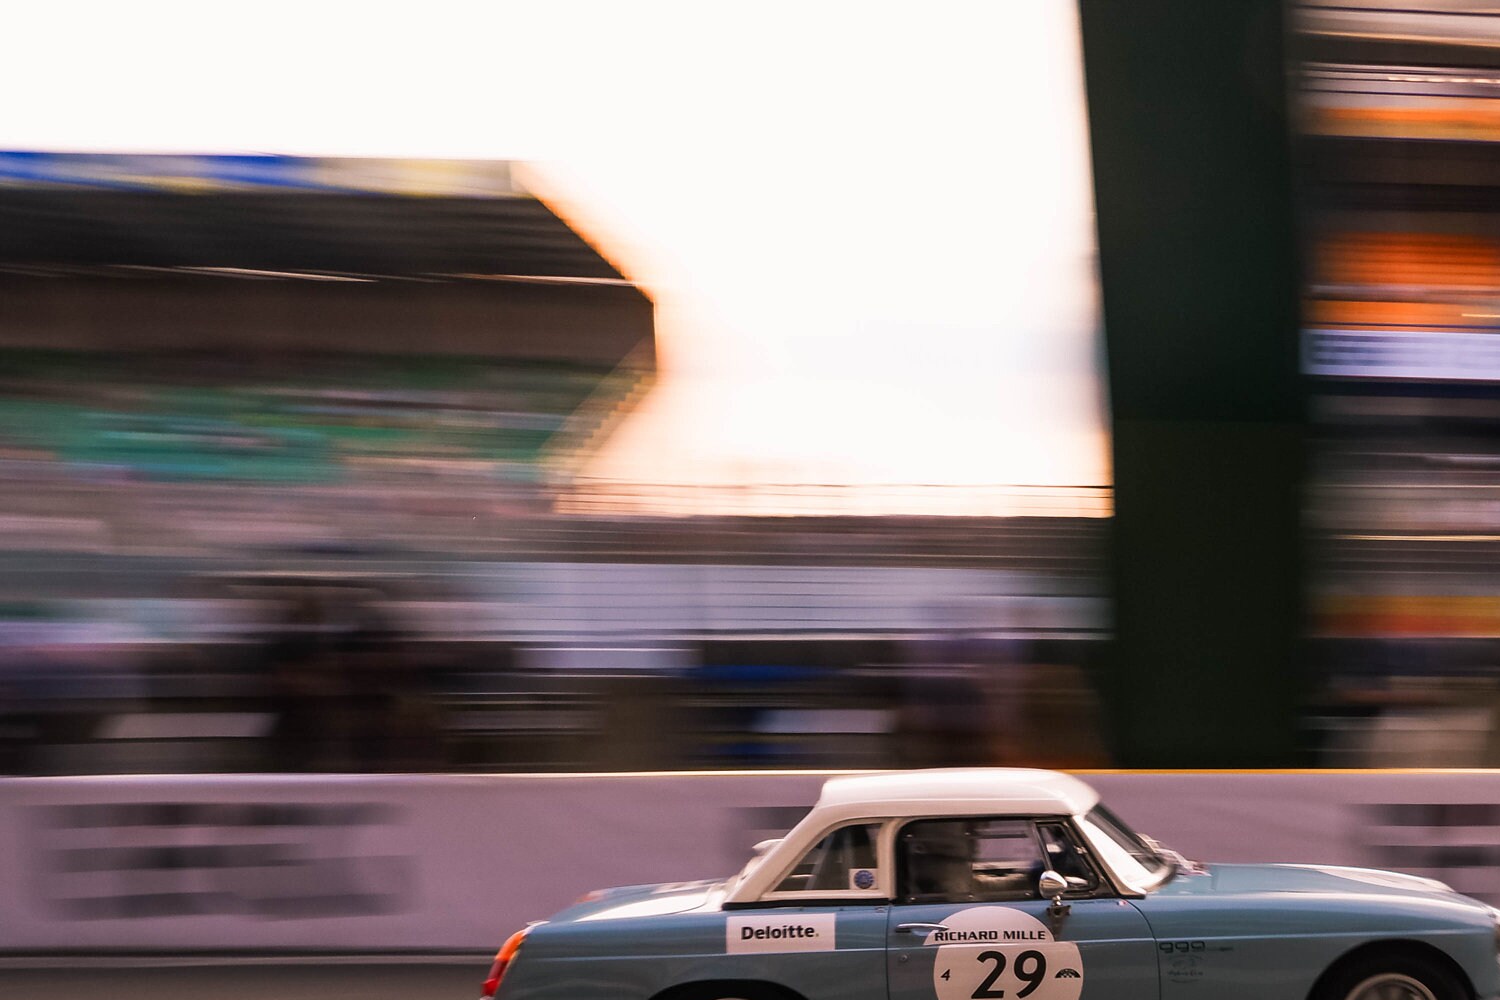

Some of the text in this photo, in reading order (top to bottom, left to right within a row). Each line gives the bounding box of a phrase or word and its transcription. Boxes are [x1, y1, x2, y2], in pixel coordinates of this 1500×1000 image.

[741, 925, 819, 940] Deloitte.
[934, 930, 1046, 942] RICHARD MILLE
[940, 968, 951, 982] 4
[970, 949, 1047, 1000] 29
